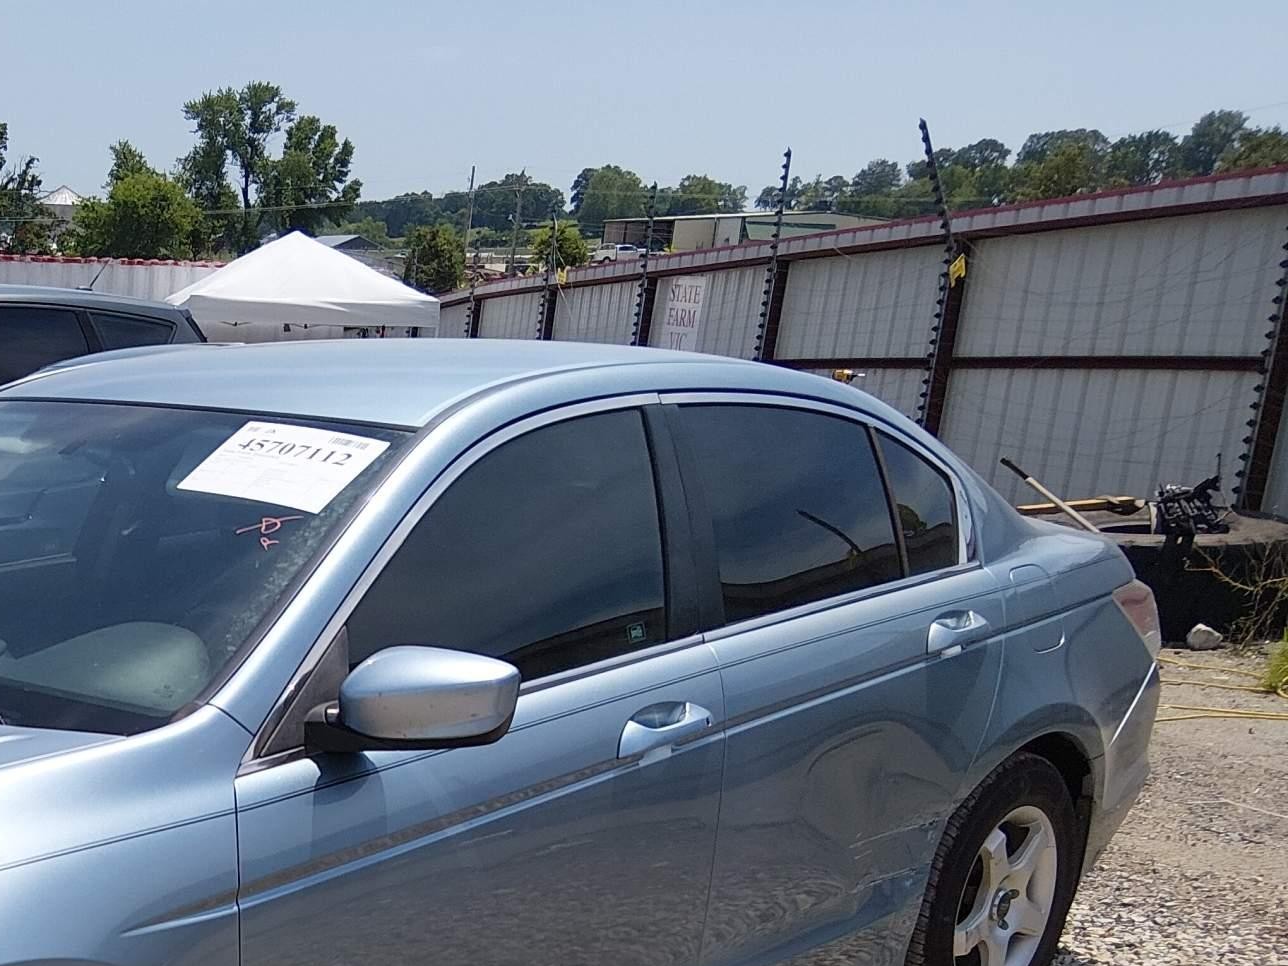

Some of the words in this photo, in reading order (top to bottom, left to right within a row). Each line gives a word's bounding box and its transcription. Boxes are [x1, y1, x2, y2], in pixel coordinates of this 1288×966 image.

[669, 284, 702, 304] STATE
[667, 307, 697, 328] FARM
[238, 438, 353, 466] 45707112
